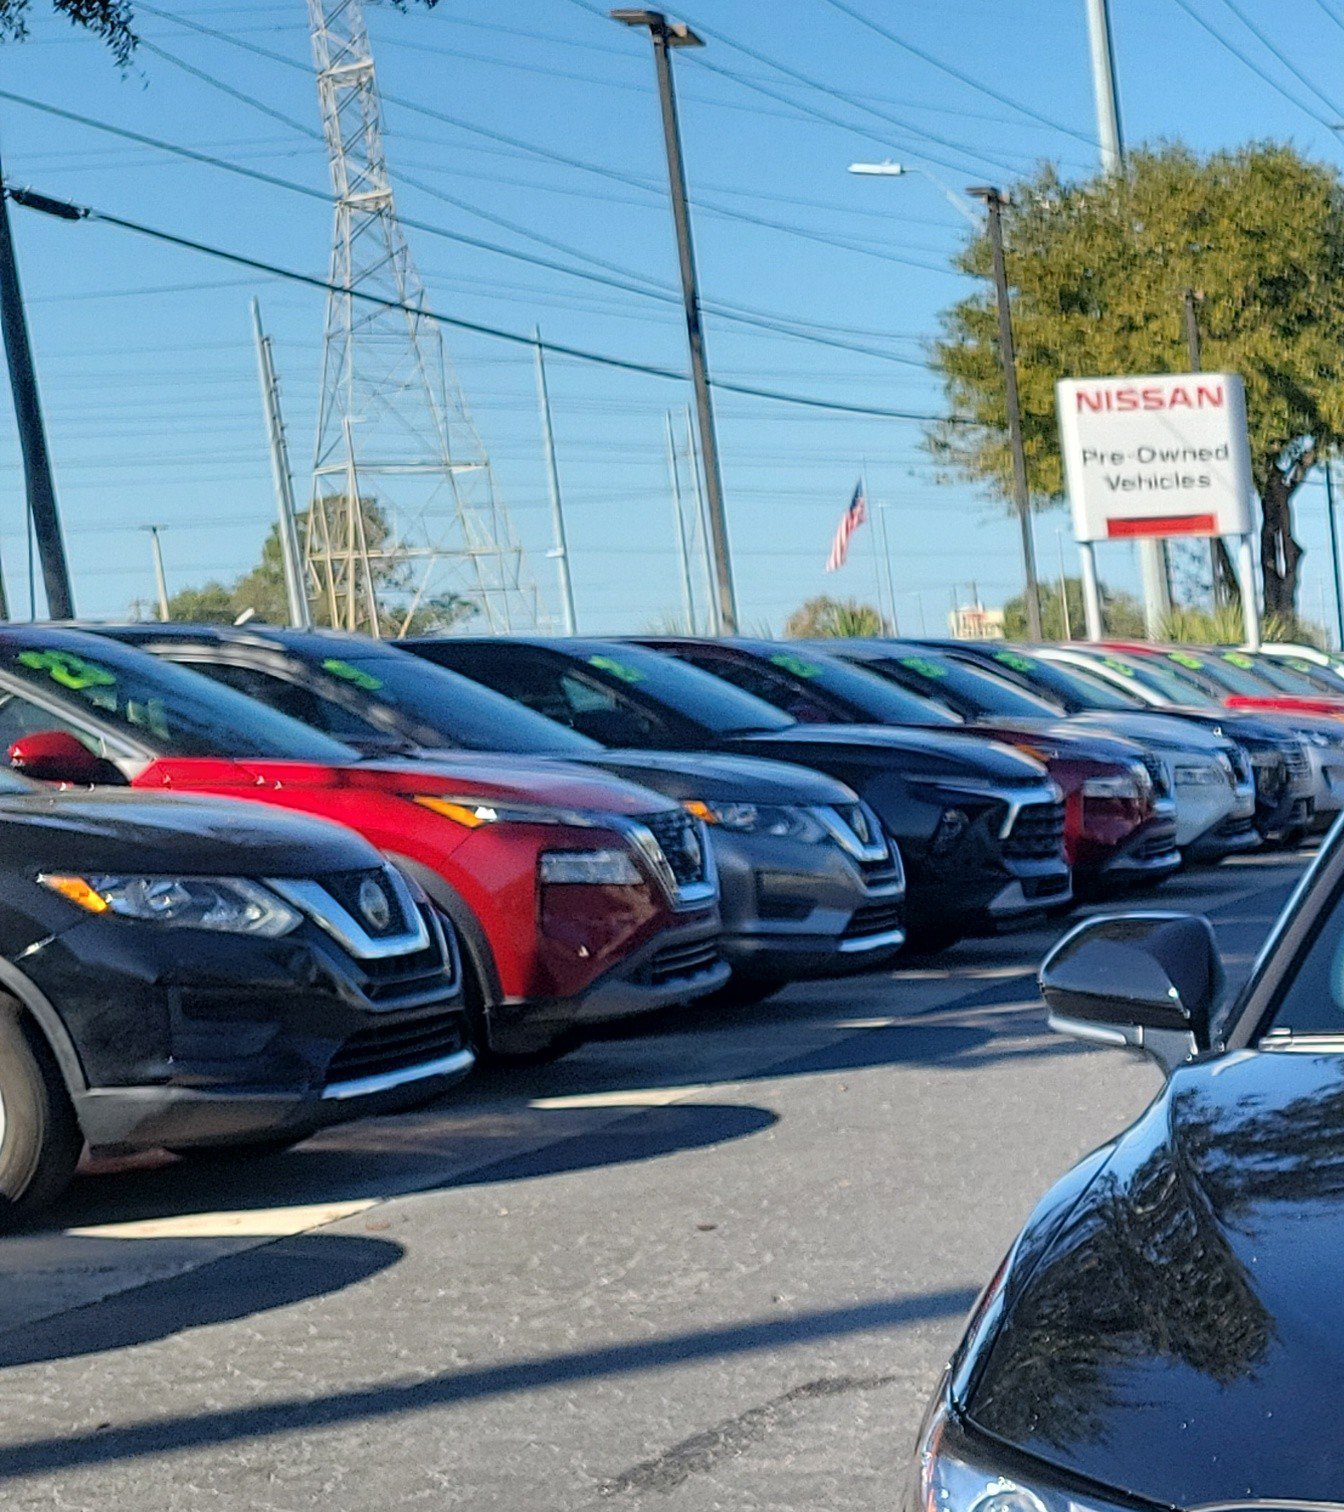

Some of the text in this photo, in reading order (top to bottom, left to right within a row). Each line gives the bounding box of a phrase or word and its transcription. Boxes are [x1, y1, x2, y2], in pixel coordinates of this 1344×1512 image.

[1076, 385, 1224, 413] NISSAN
[1082, 444, 1229, 467] Pre-Owned
[1107, 470, 1211, 492] Vehicles
